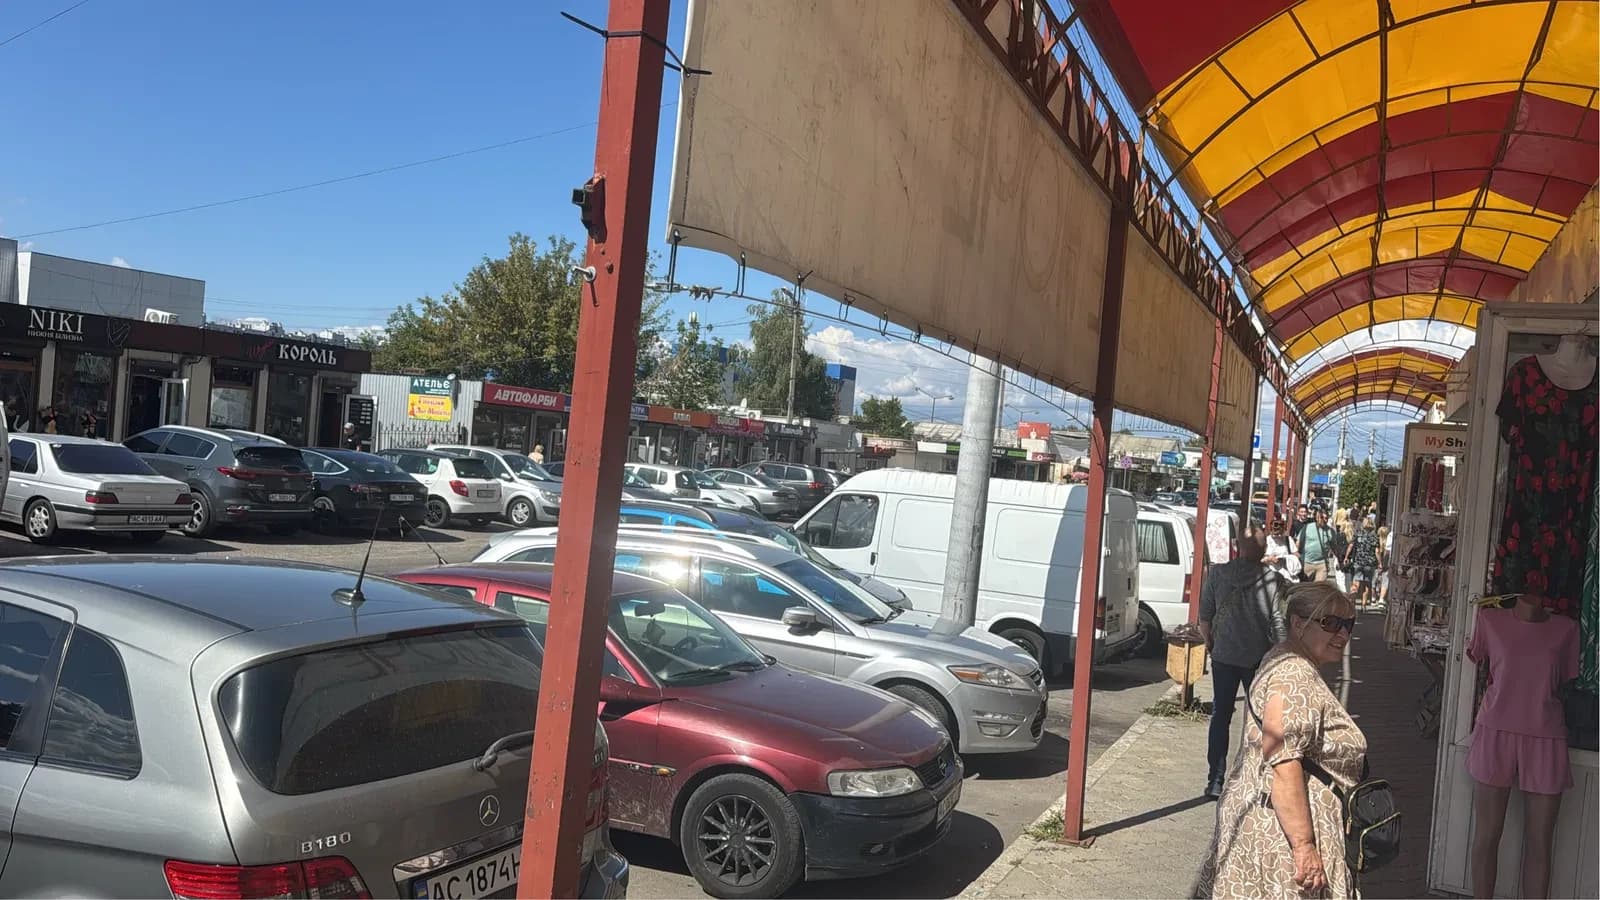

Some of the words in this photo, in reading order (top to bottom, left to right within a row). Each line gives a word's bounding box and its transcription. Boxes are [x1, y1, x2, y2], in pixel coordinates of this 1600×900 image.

[28, 308, 84, 334] NIKI
[278, 343, 337, 365] КОРОЛЬ
[413, 379, 450, 389] АТЕЛЬЄ
[494, 389, 557, 407] АВТОФАРБИ
[301, 832, 351, 853] B180
